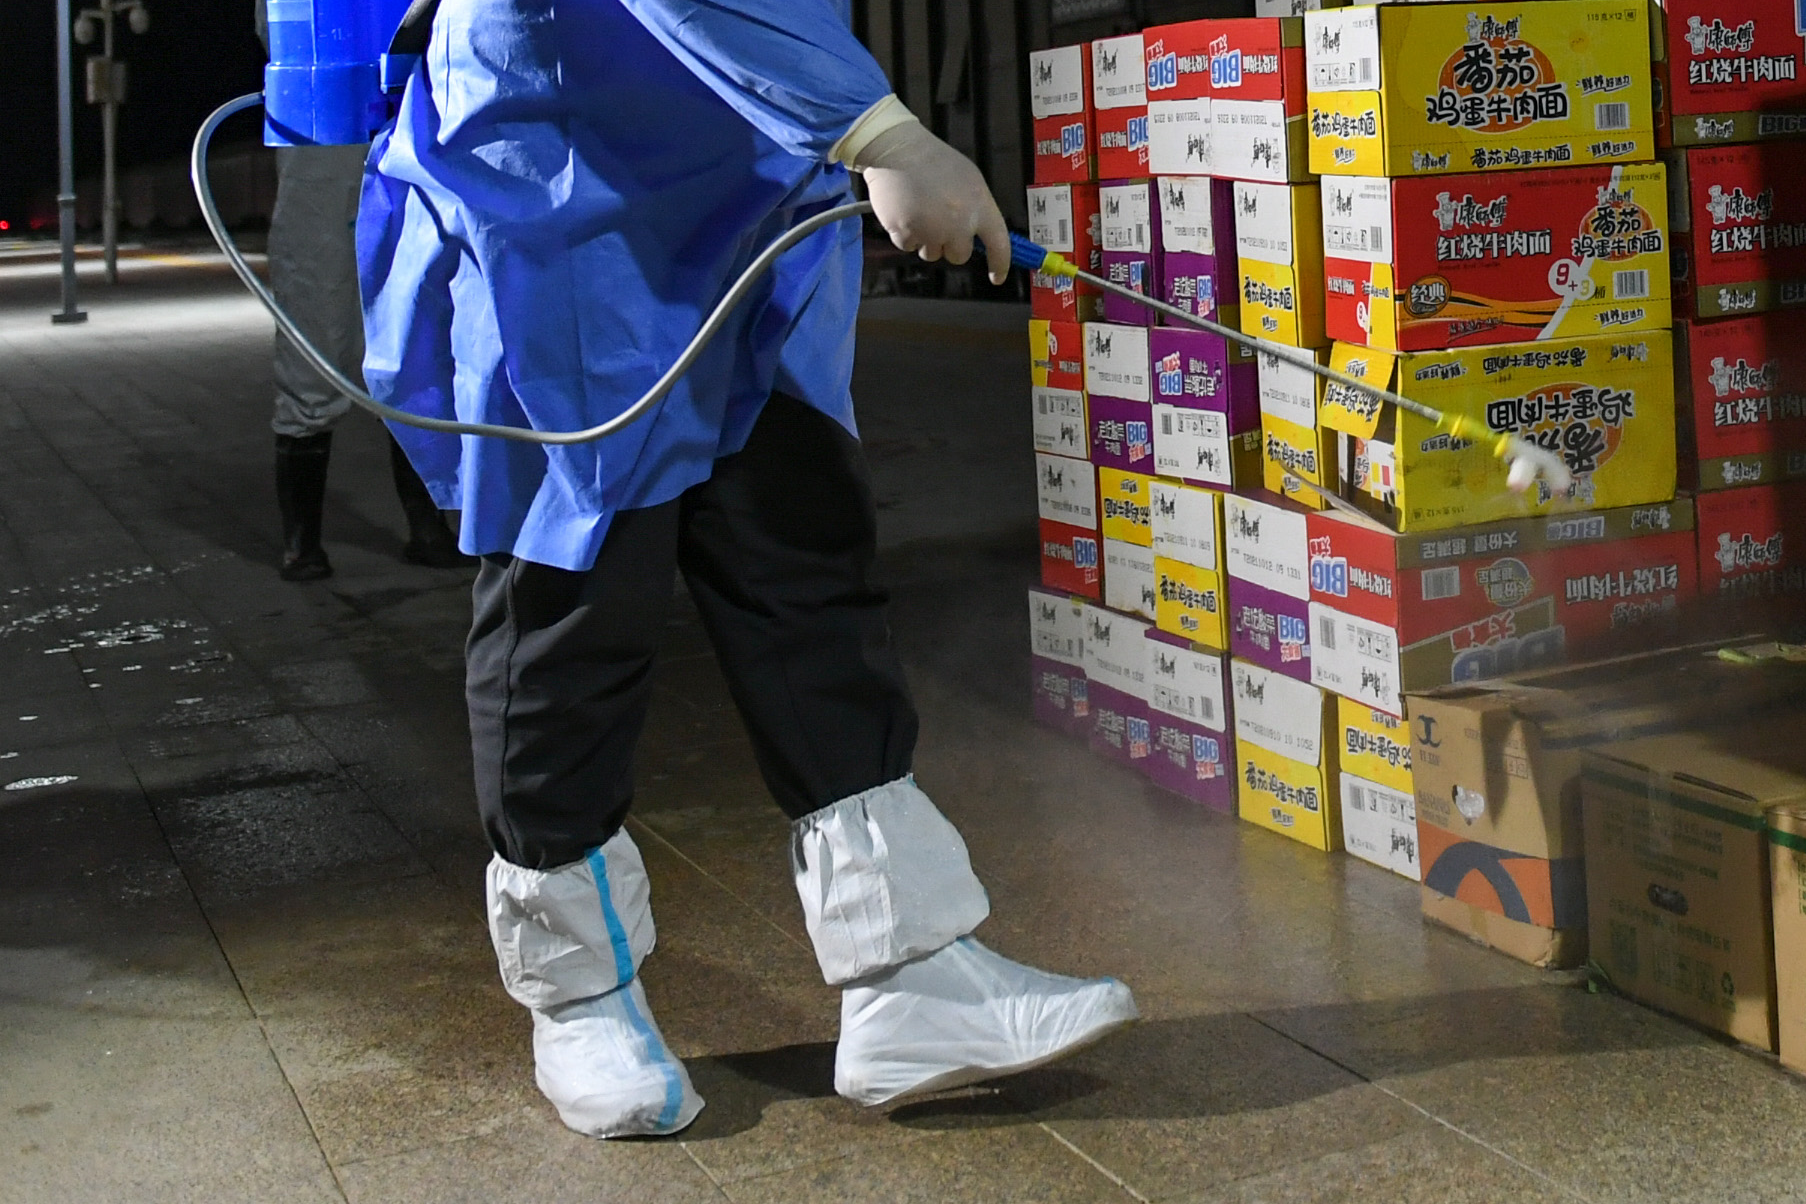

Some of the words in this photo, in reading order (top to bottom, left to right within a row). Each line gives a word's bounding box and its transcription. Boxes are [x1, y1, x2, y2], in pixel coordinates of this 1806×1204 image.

[1147, 52, 1178, 91] BIG
[1209, 48, 1242, 89] BIG
[1453, 43, 1536, 95] 番茄
[1688, 54, 1796, 86] 红烧牛肉面
[1425, 83, 1569, 129] 鸡蛋牛肉面
[1311, 108, 1377, 140] 番茄鸡蛋牛肉面
[1060, 122, 1085, 159] BIG
[1470, 144, 1573, 169] 番茄鸡蛋牛肉面
[1590, 206, 1643, 237] 番茄
[1435, 229, 1553, 263] 红烧牛肉面
[1571, 229, 1662, 258] 鸡蛋牛肉面
[1483, 347, 1588, 375] 番茄鸡蛋牛肉面
[1159, 370, 1183, 396] BIG
[1486, 387, 1635, 432] 鸡蛋牛肉面
[1126, 420, 1148, 446] BIG
[1073, 536, 1098, 568] BIG
[1310, 555, 1348, 597] BIG
[1566, 564, 1680, 606] 红烧牛肉面
[1278, 613, 1306, 645] BIG
[1126, 716, 1151, 744] BIG
[1193, 735, 1220, 764] BIG
